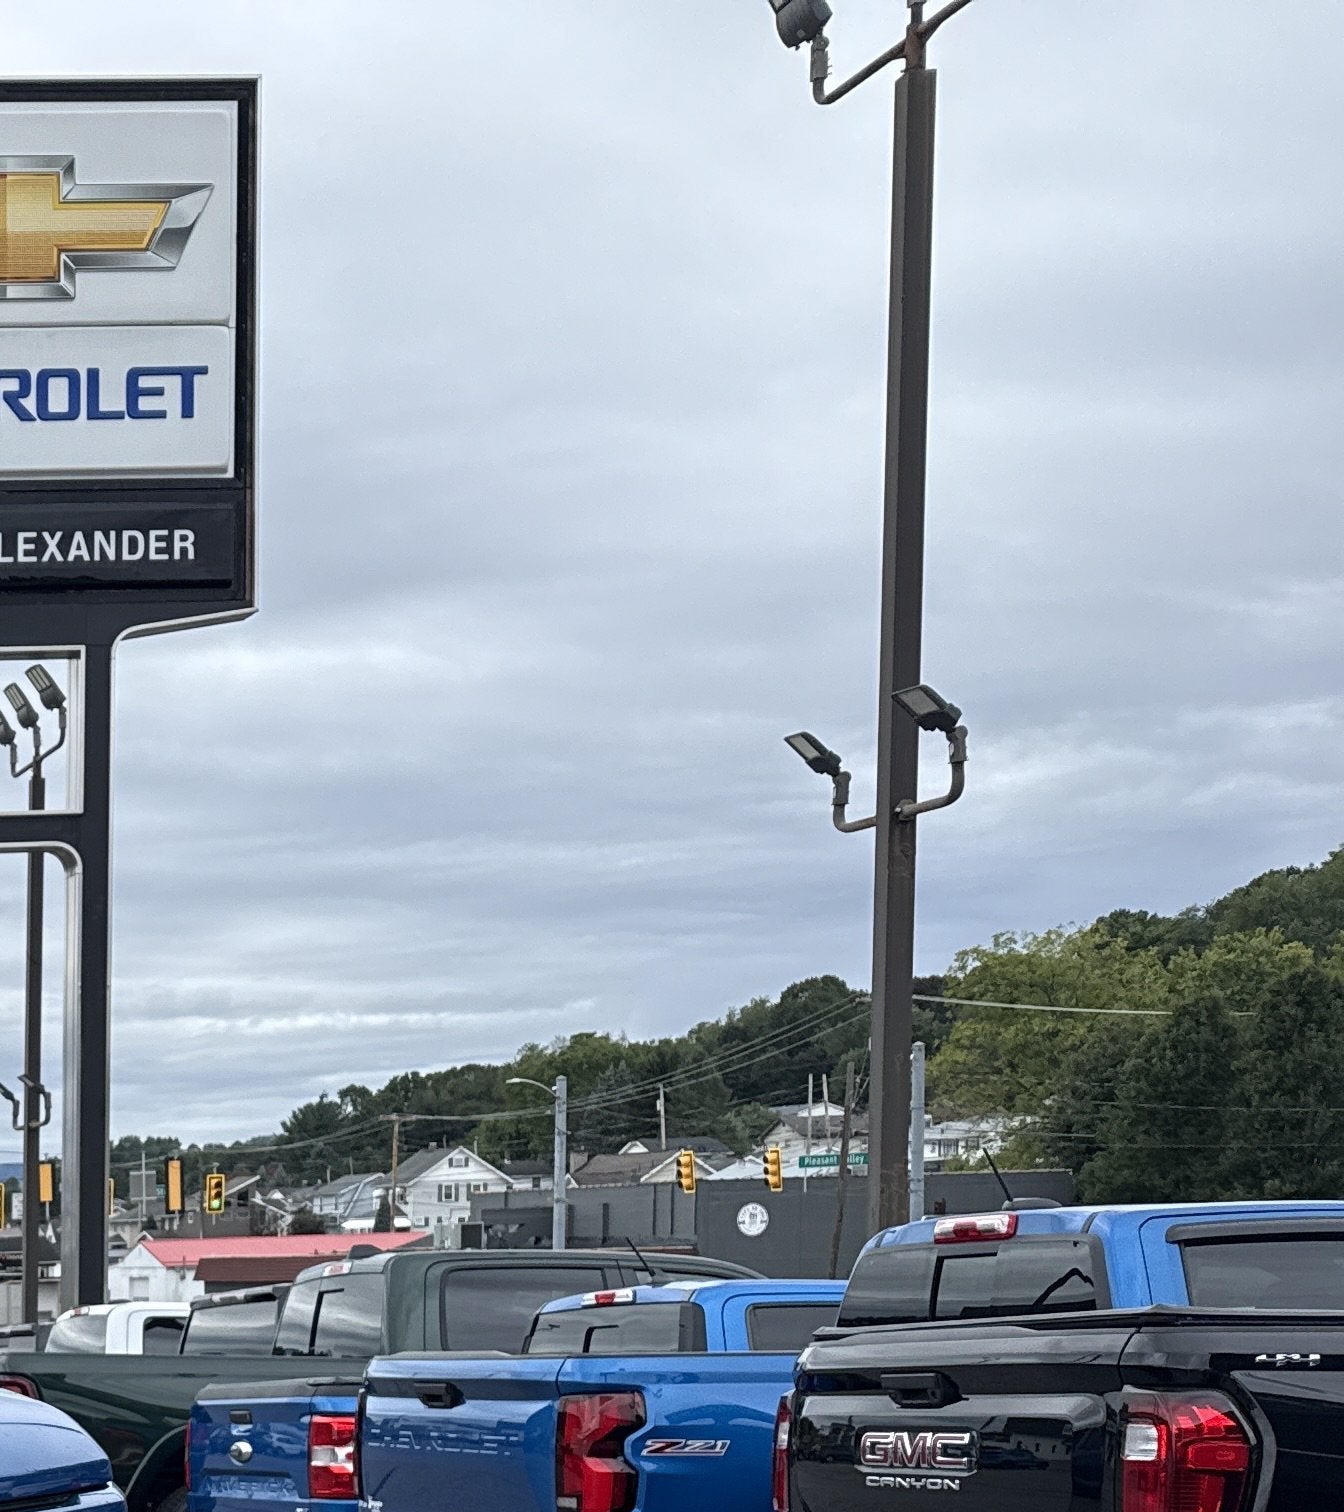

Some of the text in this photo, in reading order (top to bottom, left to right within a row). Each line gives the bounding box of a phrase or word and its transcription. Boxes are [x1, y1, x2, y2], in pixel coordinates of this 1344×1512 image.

[804, 1155, 838, 1166] Pleasant
[640, 1438, 731, 1457] Z71
[861, 1431, 971, 1469] GMC
[865, 1475, 961, 1491] CANYON
